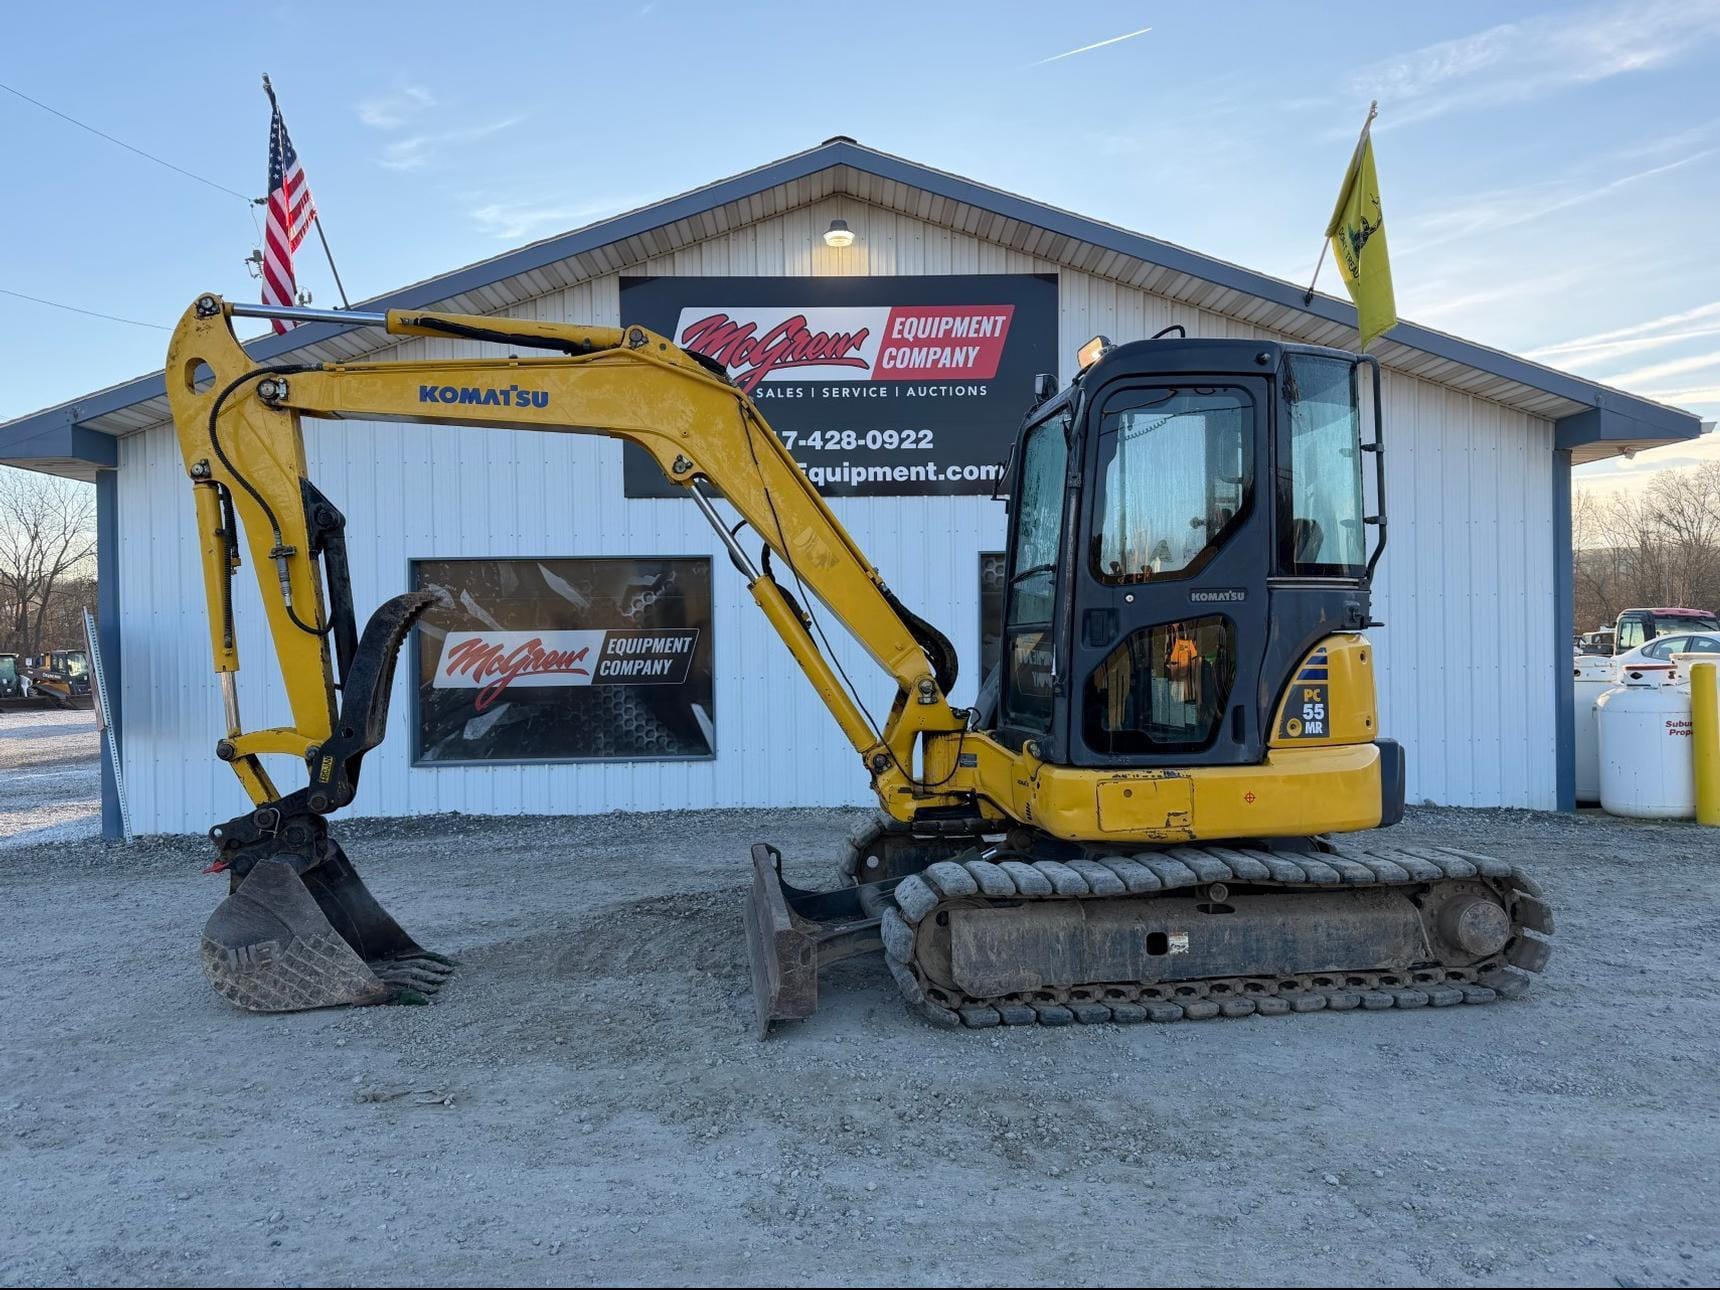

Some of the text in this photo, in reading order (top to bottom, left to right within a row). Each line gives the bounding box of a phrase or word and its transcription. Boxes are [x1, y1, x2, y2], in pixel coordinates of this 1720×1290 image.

[891, 315, 1006, 341] EQUIPMENT
[681, 313, 870, 392] McGrew
[882, 346, 980, 370] COMPANY
[418, 384, 549, 408] KOMATSU
[756, 385, 988, 399] SALES SERVICE AUCTIONS
[773, 429, 934, 450] 7-428-0922
[1191, 590, 1245, 602] KOMATSU
[606, 637, 692, 656] EQUIPMENT
[446, 637, 590, 712] McGrew
[599, 659, 673, 677] COMPANY
[1303, 688, 1321, 702] PC
[1302, 703, 1325, 720] 55
[1304, 721, 1323, 734] MR
